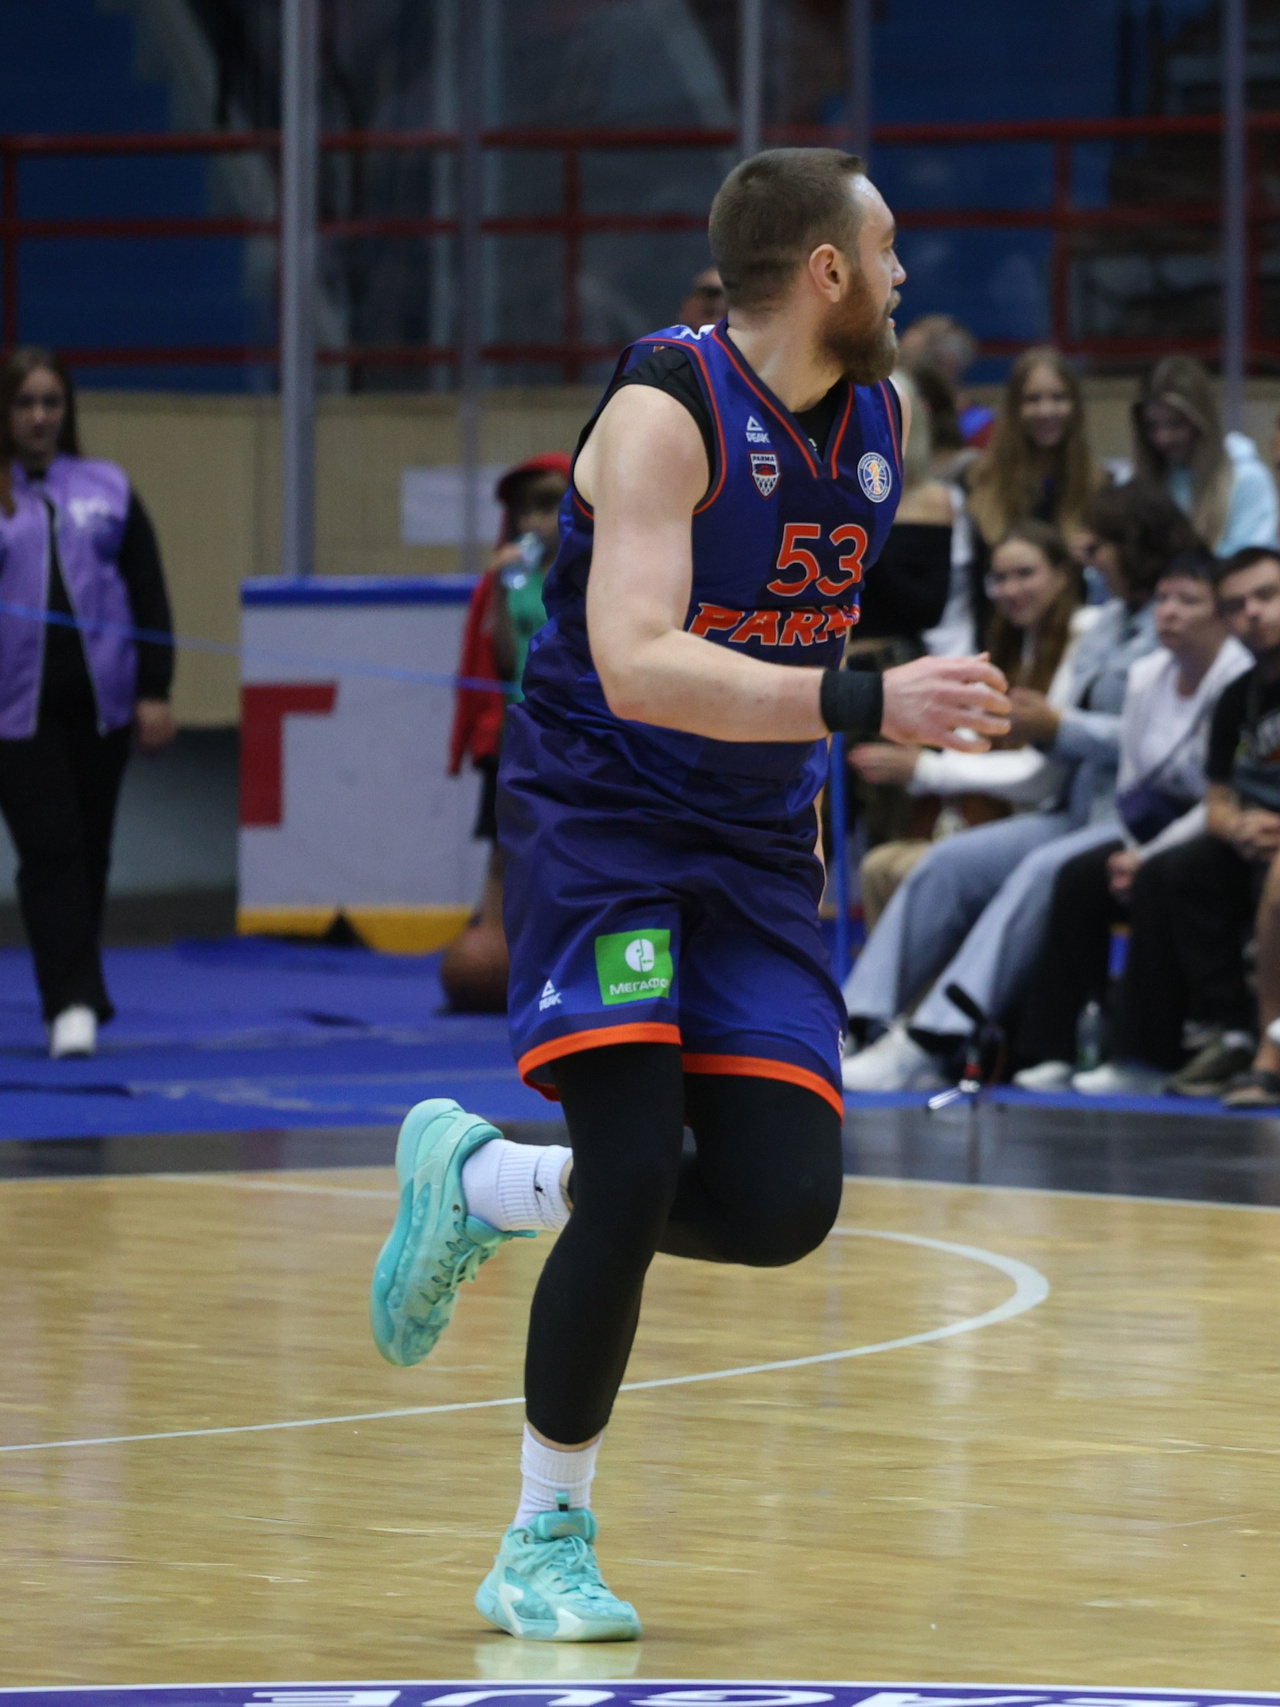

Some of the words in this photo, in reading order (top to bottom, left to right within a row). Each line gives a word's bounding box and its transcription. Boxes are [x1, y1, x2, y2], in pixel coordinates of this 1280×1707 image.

[746, 432, 770, 443] PEAK
[767, 523, 868, 597] 53
[688, 602, 860, 646] PARM
